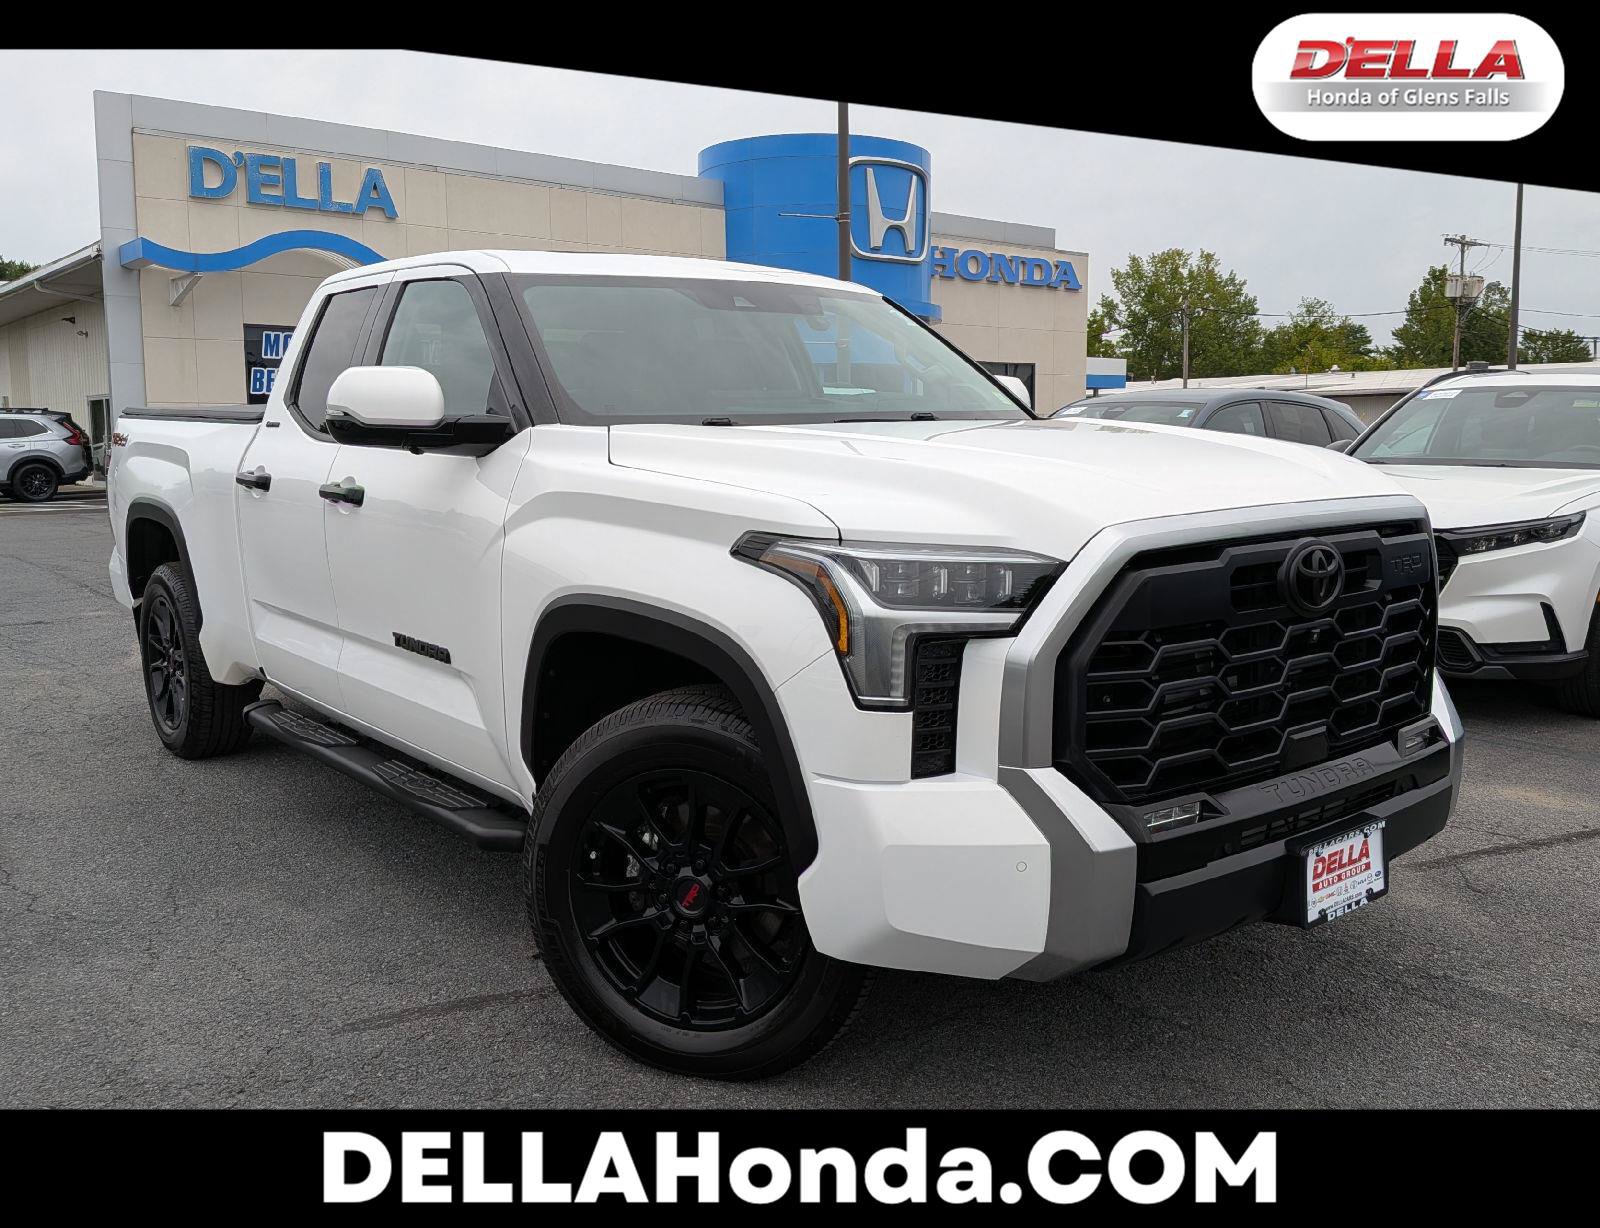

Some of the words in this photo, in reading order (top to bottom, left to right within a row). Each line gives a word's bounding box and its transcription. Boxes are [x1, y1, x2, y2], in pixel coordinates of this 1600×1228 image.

[187, 145, 399, 219] D'ELLA
[931, 245, 1083, 291] HONDA
[1258, 757, 1376, 802] TUNDRA
[1318, 873, 1338, 890] AUTO
[1341, 863, 1366, 881] GROUP
[1327, 896, 1369, 922] DELLA
